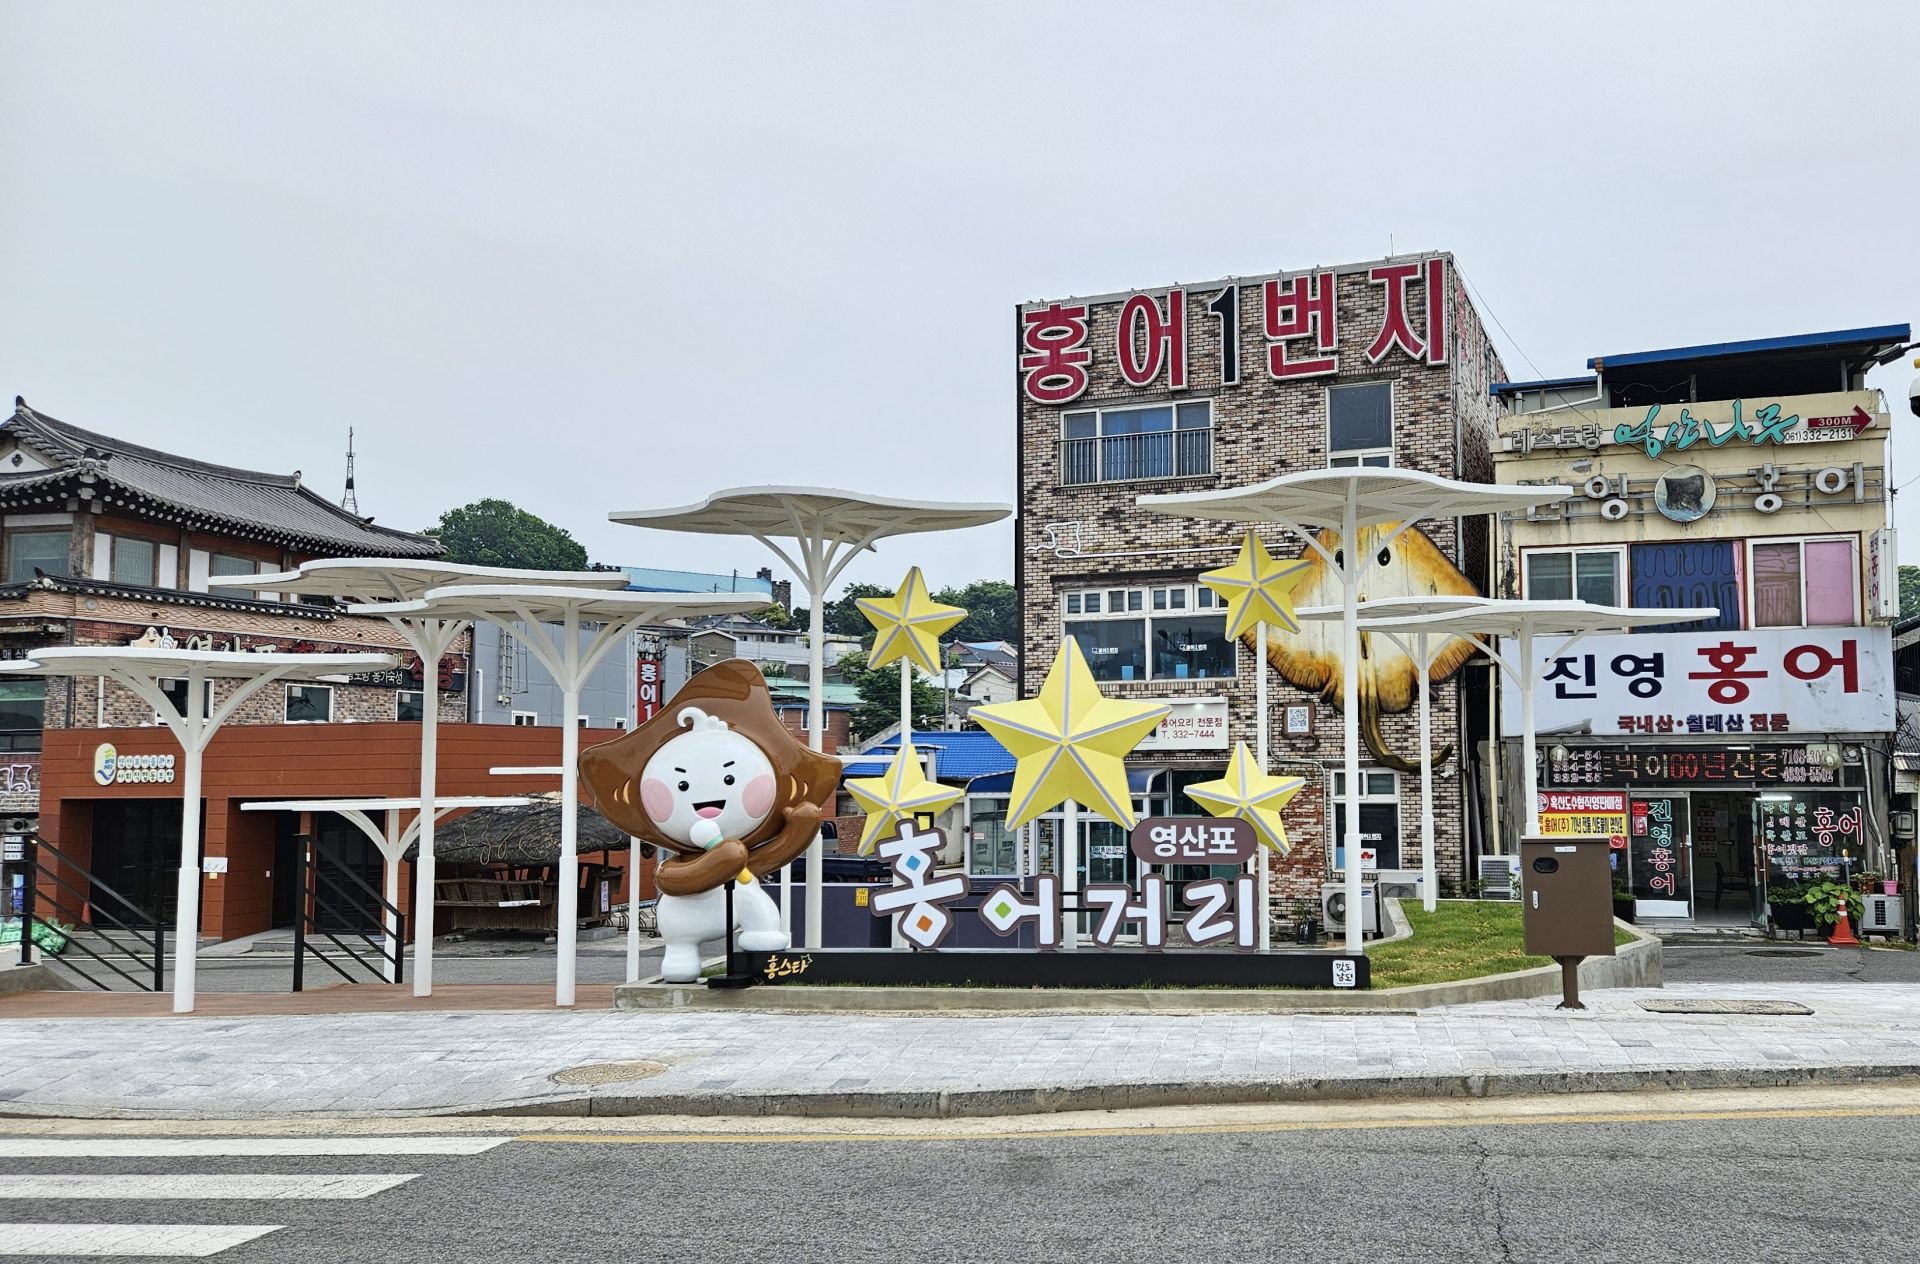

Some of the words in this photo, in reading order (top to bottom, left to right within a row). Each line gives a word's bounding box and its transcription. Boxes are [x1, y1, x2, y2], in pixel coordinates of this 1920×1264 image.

[1019, 257, 1449, 404] 홍어1번지
[1512, 423, 1602, 453] 레스토랑
[1614, 399, 1799, 459] 영산나루
[1819, 416, 1852, 427] 300M
[1747, 462, 1864, 514] 홍어
[1542, 652, 1664, 699] 진영
[1688, 639, 1859, 704] 홍어
[1161, 717, 1194, 728] 홍어요리
[1197, 717, 1223, 728] 전문점
[1173, 730, 1215, 739] 332-7444
[1750, 713, 1790, 732] 전문
[1150, 826, 1239, 857] 영산포
[1812, 807, 1863, 847] 홍어
[873, 820, 1257, 950] 홍어거리
[763, 954, 809, 980] 홍스타
[1336, 962, 1353, 973] 맛도
